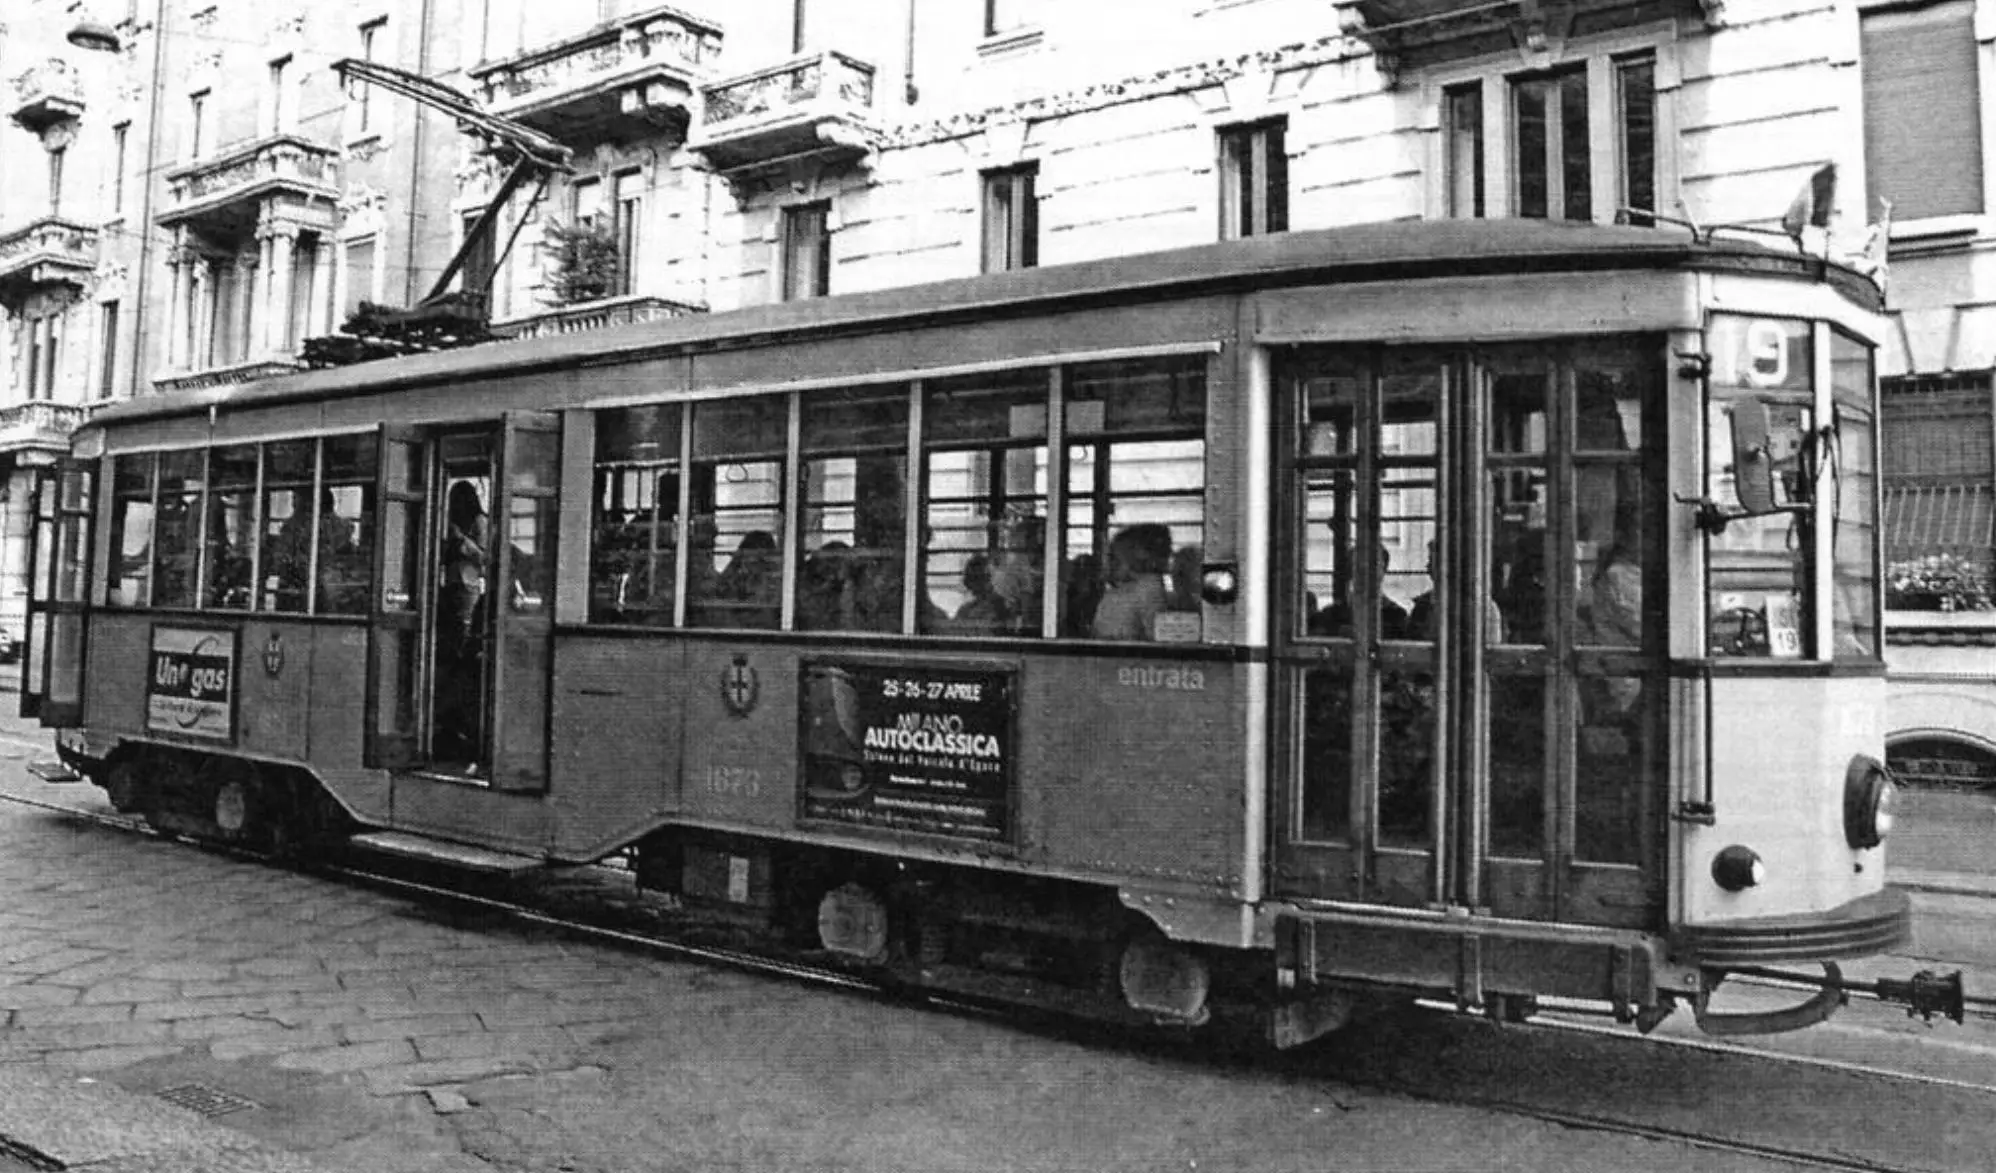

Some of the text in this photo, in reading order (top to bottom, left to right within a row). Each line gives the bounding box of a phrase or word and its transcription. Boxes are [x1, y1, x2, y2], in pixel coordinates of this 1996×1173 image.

[1718, 318, 1787, 386] 19
[1777, 629, 1797, 649] 19
[1118, 665, 1204, 690] entrata
[864, 726, 1000, 758] AUTOCLASSICA
